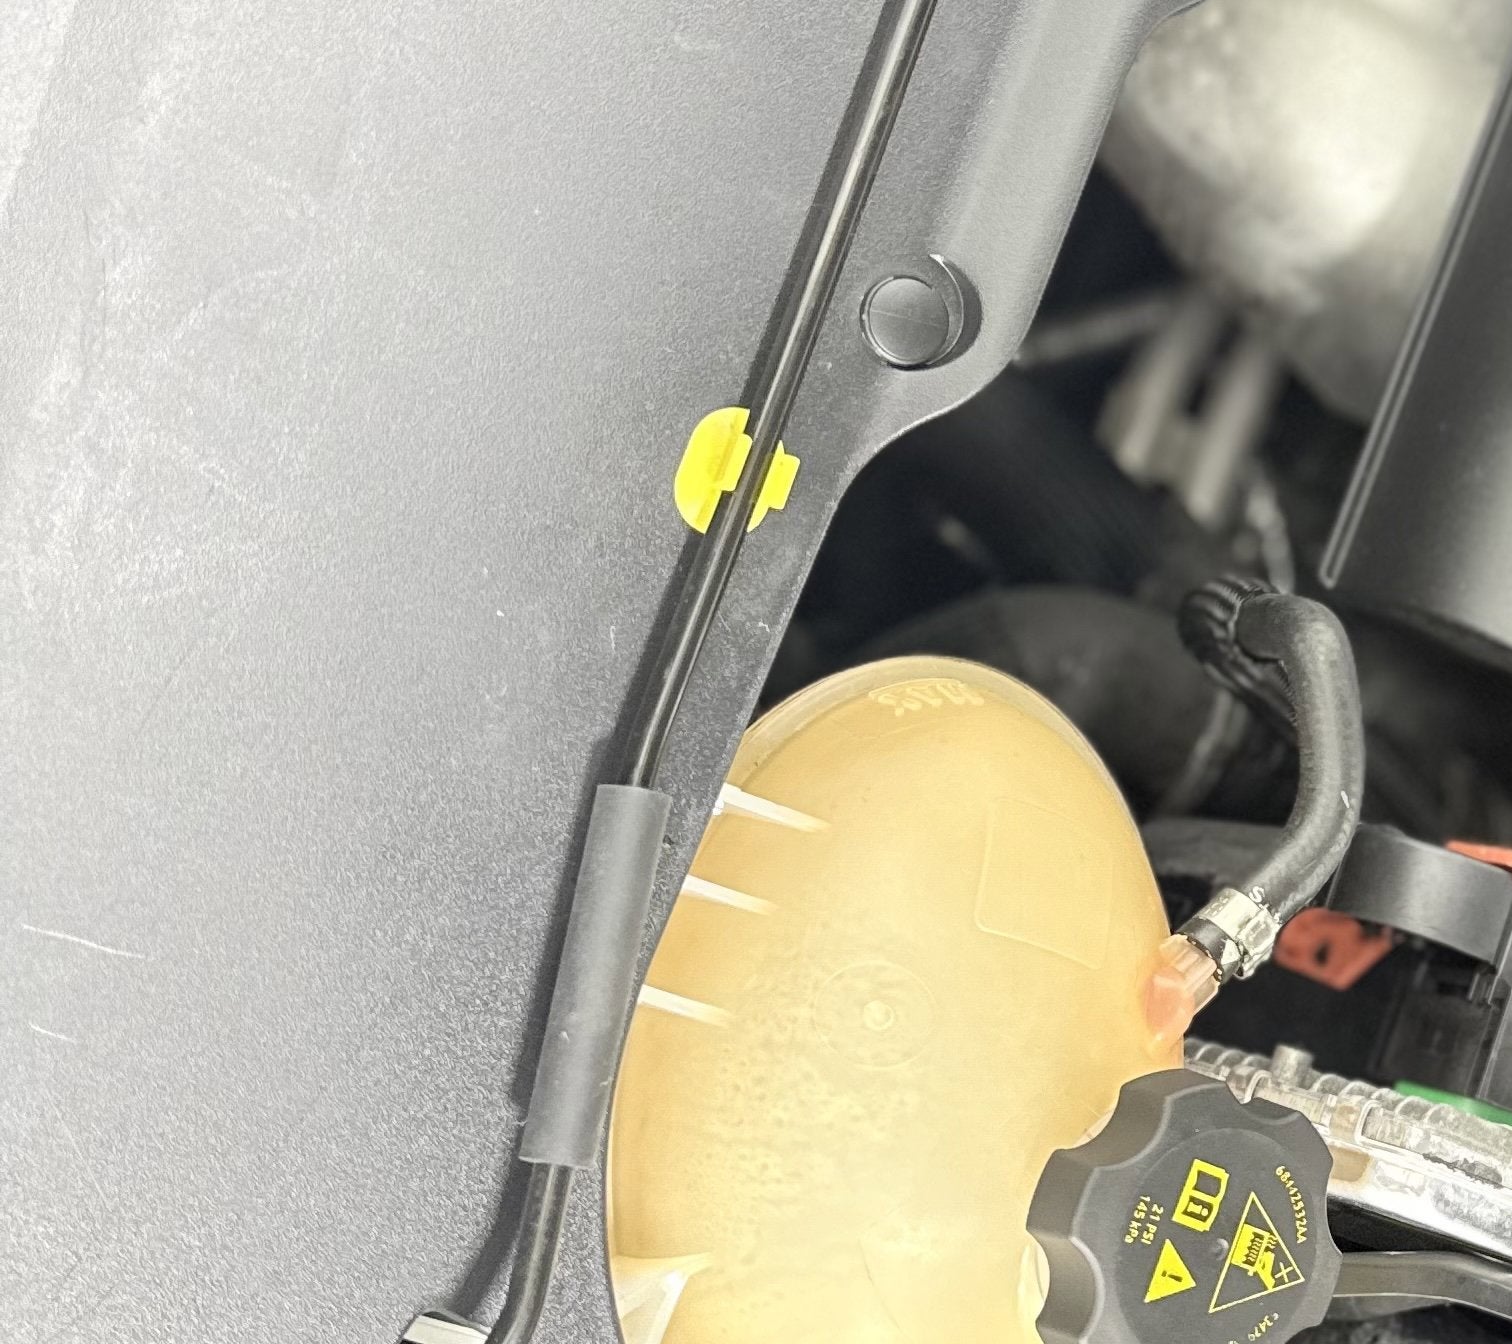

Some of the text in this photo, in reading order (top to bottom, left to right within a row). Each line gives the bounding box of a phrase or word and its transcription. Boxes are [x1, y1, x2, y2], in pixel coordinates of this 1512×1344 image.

[1124, 1195, 1150, 1245] 145 kPa
[1141, 1203, 1164, 1245] 21 PSI
